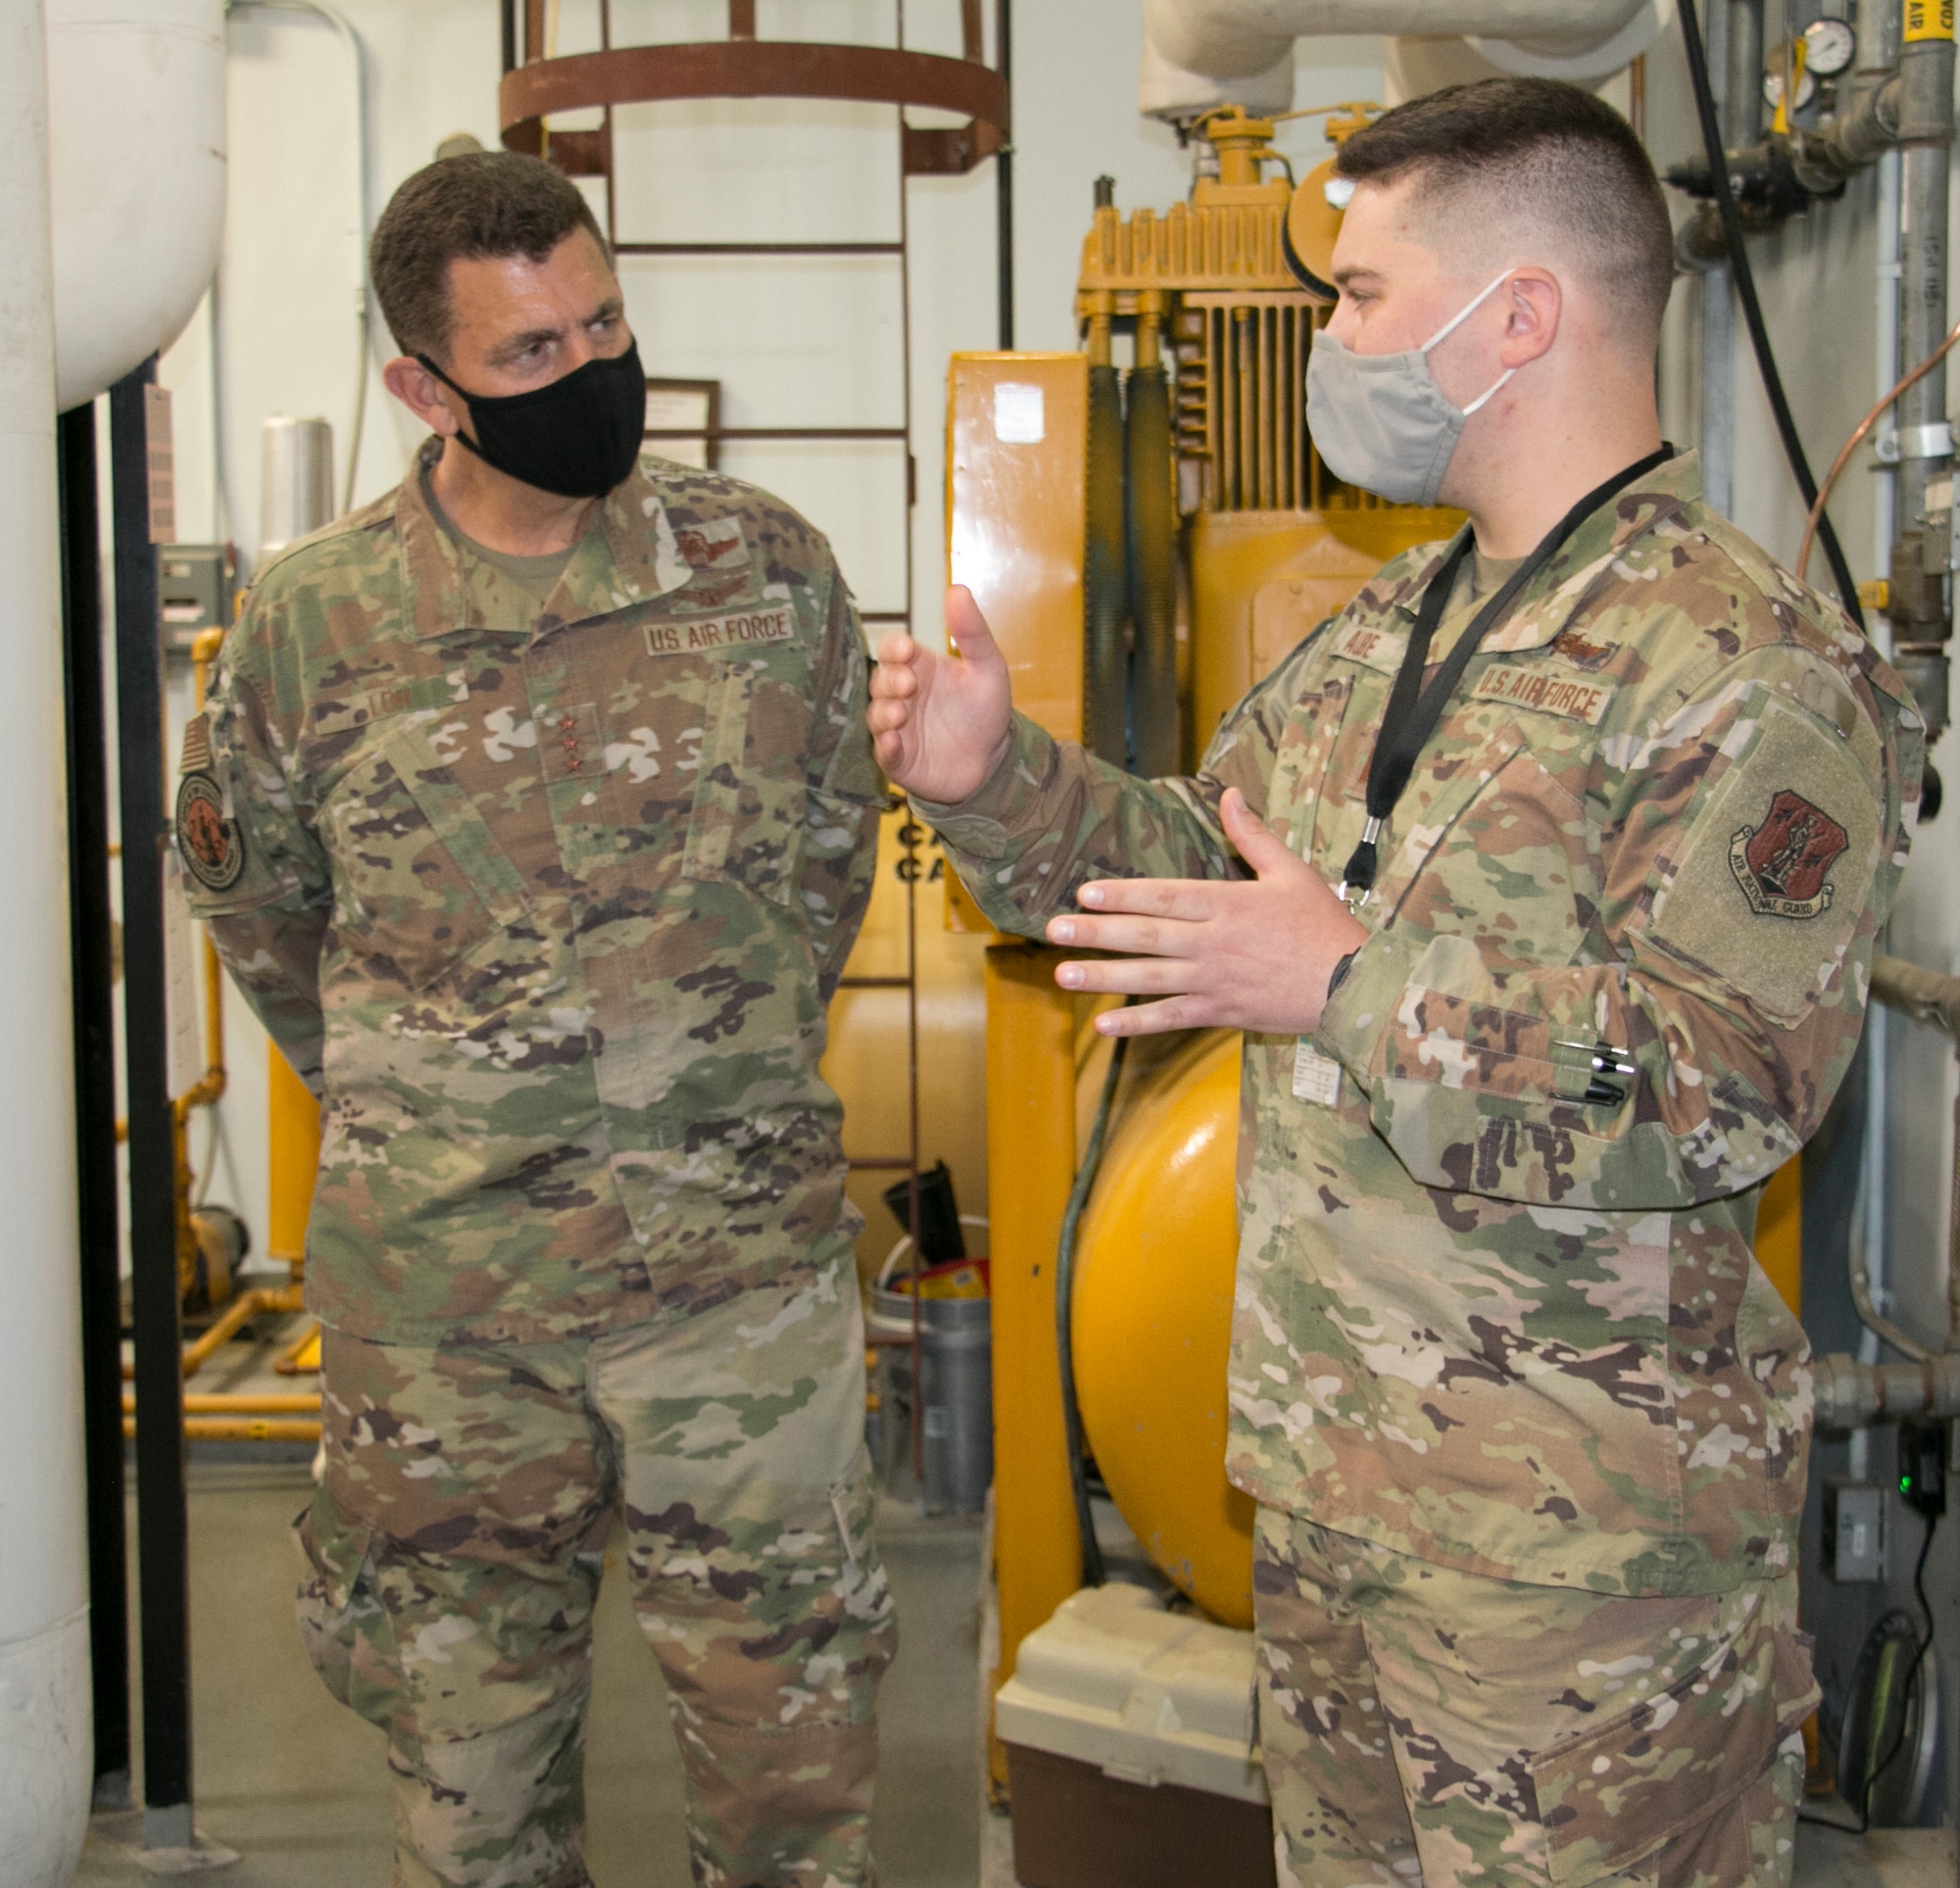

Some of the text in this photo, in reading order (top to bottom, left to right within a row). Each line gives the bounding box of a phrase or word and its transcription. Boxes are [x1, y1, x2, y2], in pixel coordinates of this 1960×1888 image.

[1909, 2, 1924, 30] AIR
[687, 623, 721, 648] AIR
[724, 613, 788, 642] FORCE
[1478, 668, 1602, 717] U.S. AIR FORCE
[898, 824, 940, 847] C
[1731, 854, 1813, 914] AIR NATIONAL GUARD
